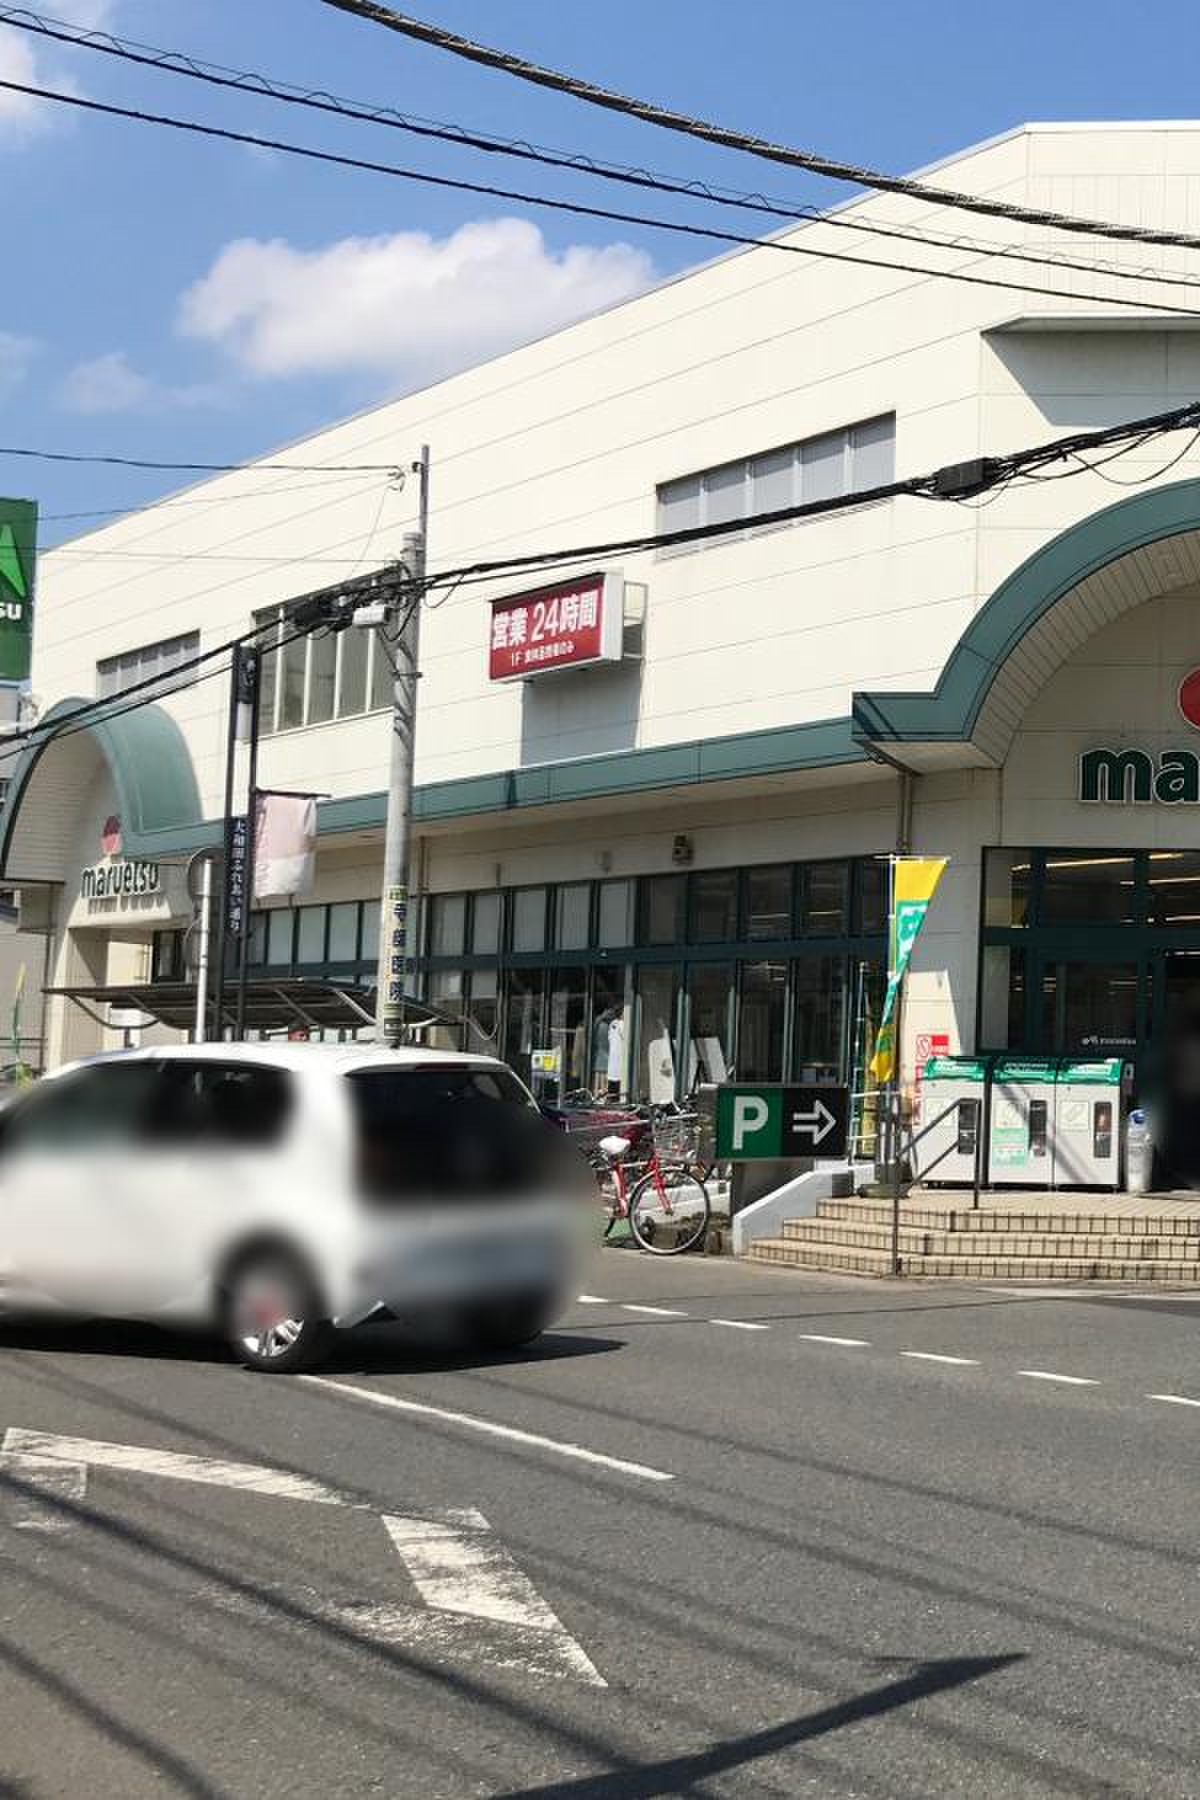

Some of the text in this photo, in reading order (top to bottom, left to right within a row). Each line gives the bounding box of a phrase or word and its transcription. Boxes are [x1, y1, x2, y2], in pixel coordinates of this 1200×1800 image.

[493, 589, 598, 650] 営業 24時間
[82, 862, 159, 896] maruetsu
[732, 1095, 769, 1150] P
